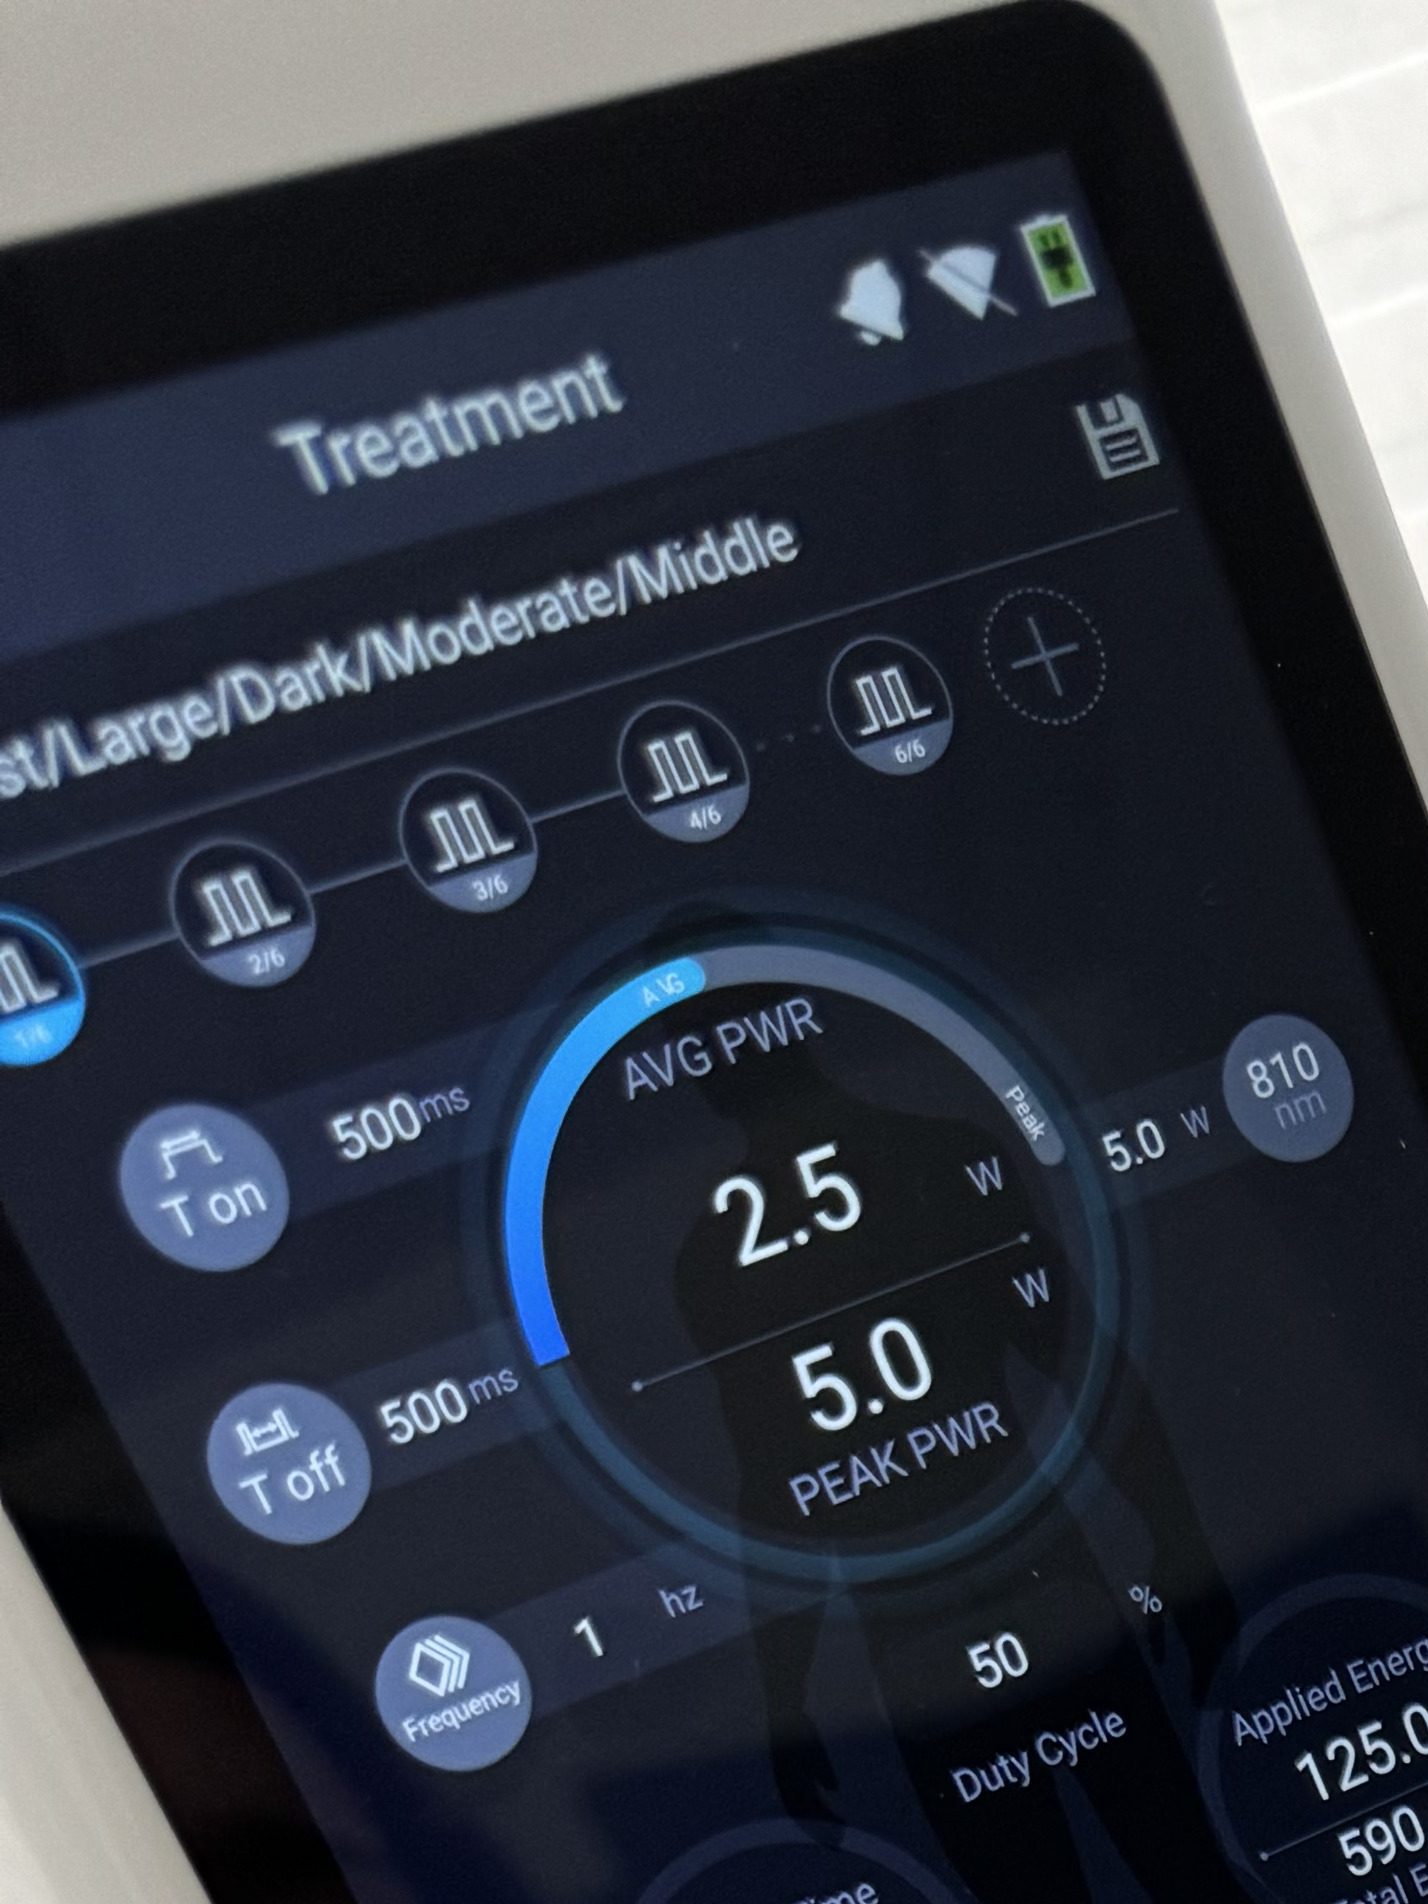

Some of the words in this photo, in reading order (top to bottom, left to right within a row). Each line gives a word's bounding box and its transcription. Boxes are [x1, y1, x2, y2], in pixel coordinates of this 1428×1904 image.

[273, 351, 626, 495] Treatment
[895, 736, 926, 766] 6/6
[688, 803, 723, 832] 4/6
[473, 872, 509, 903] 3/6
[248, 946, 286, 976] 2/6
[621, 1036, 714, 1100] AVG
[714, 997, 823, 1065] PWR
[1245, 1041, 1321, 1100] 810
[1004, 1085, 1046, 1142] Peak
[1101, 1118, 1167, 1174] 5.0
[1181, 1104, 1211, 1139] W
[1273, 1089, 1327, 1130] nm
[160, 1195, 195, 1239] T
[208, 1175, 268, 1226] on
[712, 1141, 862, 1268] 2.5
[964, 1156, 1004, 1196] W
[1012, 1268, 1050, 1309] W
[790, 1316, 933, 1432] 5.0
[239, 1472, 273, 1516] T
[289, 1444, 348, 1503] off
[788, 1437, 908, 1517] PEAK
[905, 1400, 1009, 1471] PWR
[572, 1615, 604, 1657] 1
[658, 1584, 704, 1618] hz
[966, 1631, 1030, 1689] 50
[1128, 1584, 1164, 1615] %
[401, 1680, 522, 1742] Frequency
[1231, 1669, 1347, 1747] Applied
[950, 1750, 1032, 1804] Duty
[1035, 1707, 1127, 1769] Cycle
